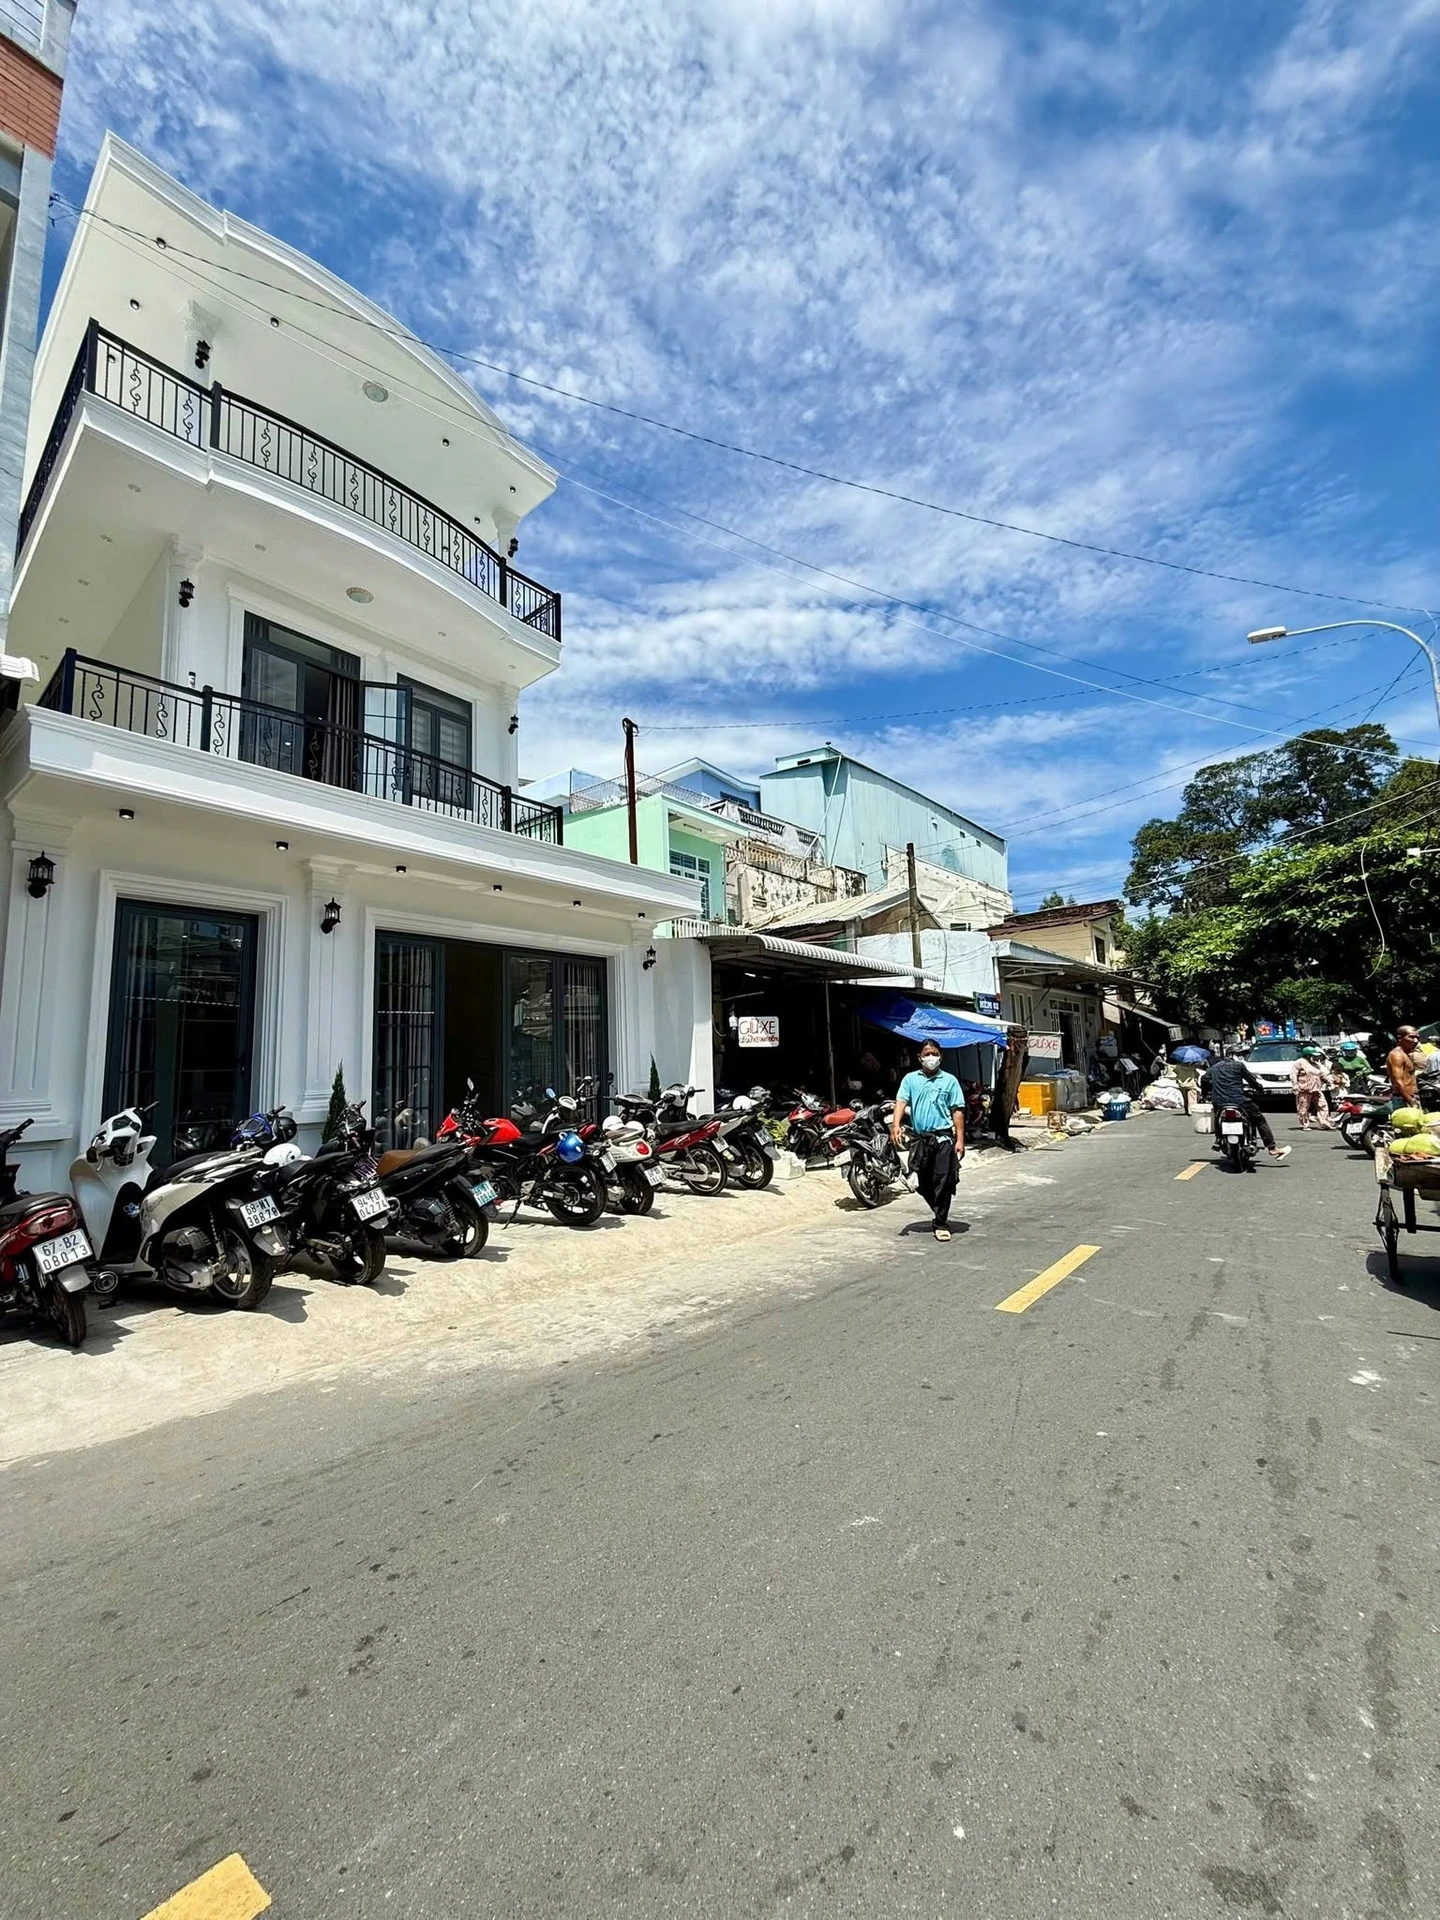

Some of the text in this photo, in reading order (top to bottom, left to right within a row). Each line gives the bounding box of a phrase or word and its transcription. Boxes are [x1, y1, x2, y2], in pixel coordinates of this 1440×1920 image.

[760, 1020, 776, 1035] XE
[42, 1234, 79, 1257] 67-B2
[42, 1244, 88, 1271] 080.13
